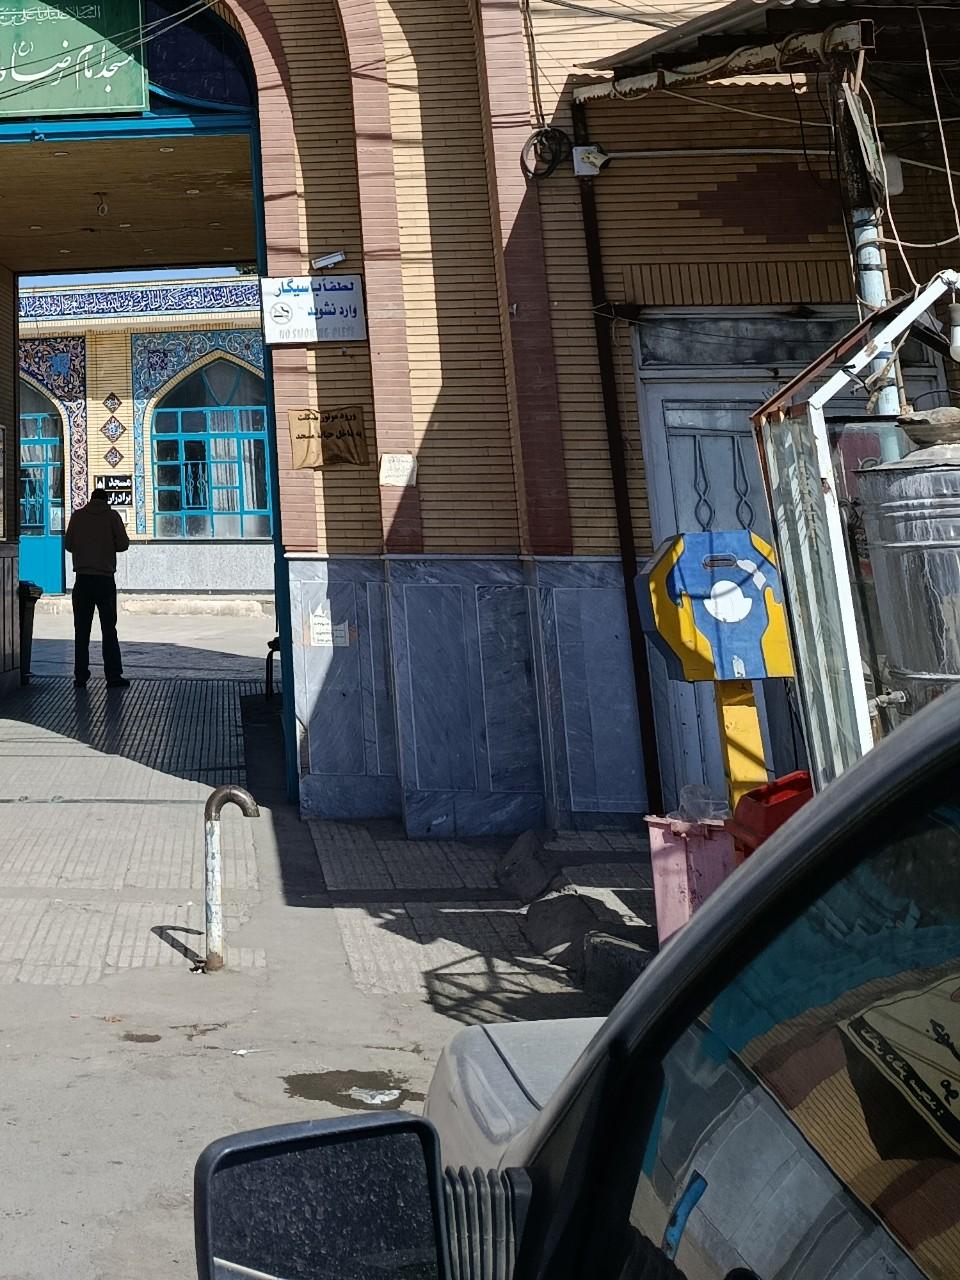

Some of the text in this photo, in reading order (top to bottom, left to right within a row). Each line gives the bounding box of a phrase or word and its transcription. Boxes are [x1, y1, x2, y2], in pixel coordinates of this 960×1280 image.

[10, 40, 72, 86] رضا
[75, 43, 106, 90] امام
[94, 52, 135, 93] مسجد
[274, 278, 310, 297] سیگار
[307, 301, 358, 320] وارد نشوید
[108, 477, 132, 490] مسجد
